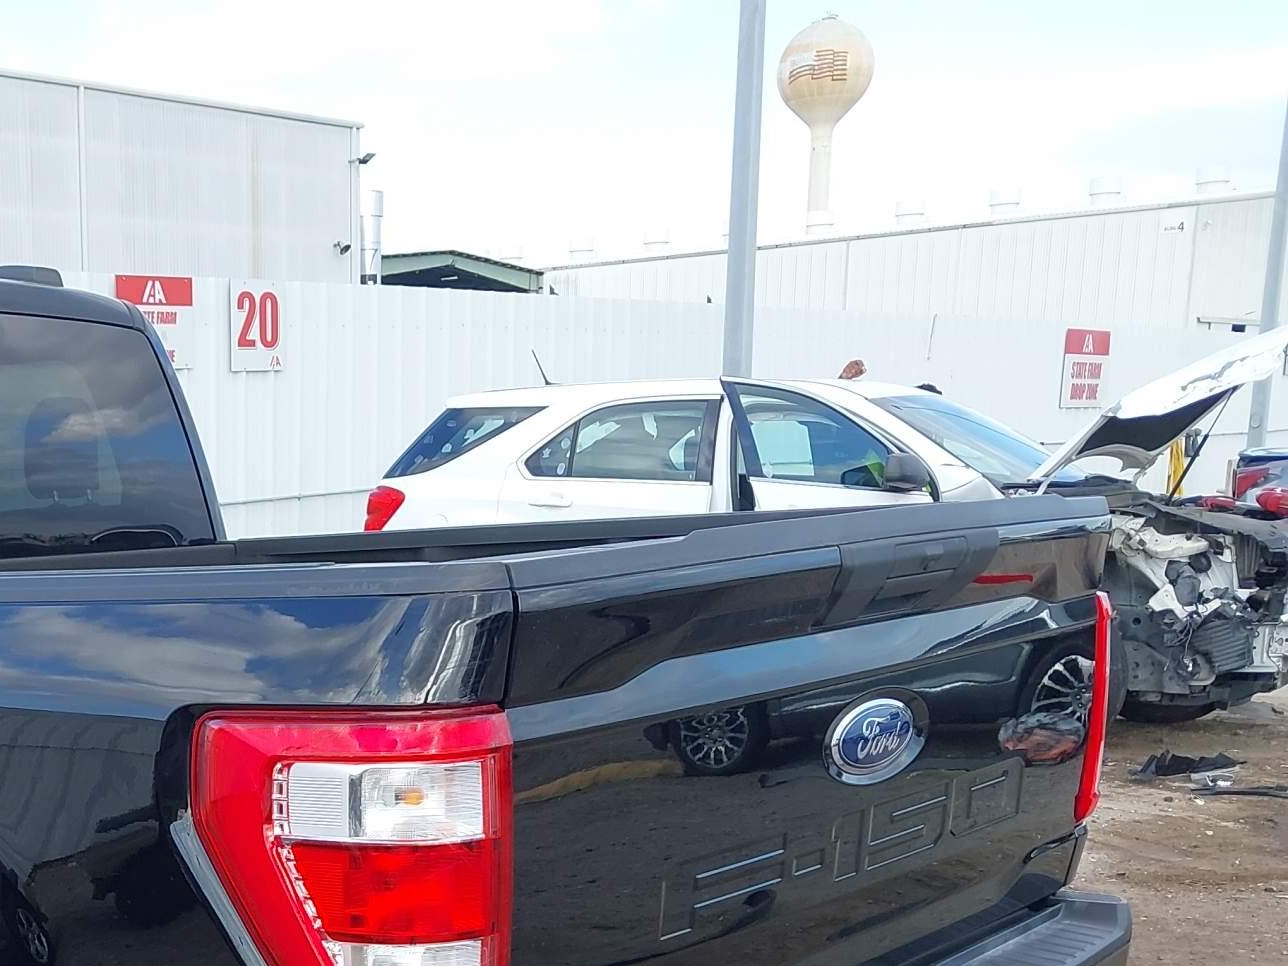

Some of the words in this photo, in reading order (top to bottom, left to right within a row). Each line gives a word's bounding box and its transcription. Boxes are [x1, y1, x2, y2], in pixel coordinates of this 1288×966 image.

[156, 311, 177, 325] FARM
[236, 290, 280, 350] 20
[856, 711, 909, 758] Ford
[659, 757, 1024, 941] F-150
